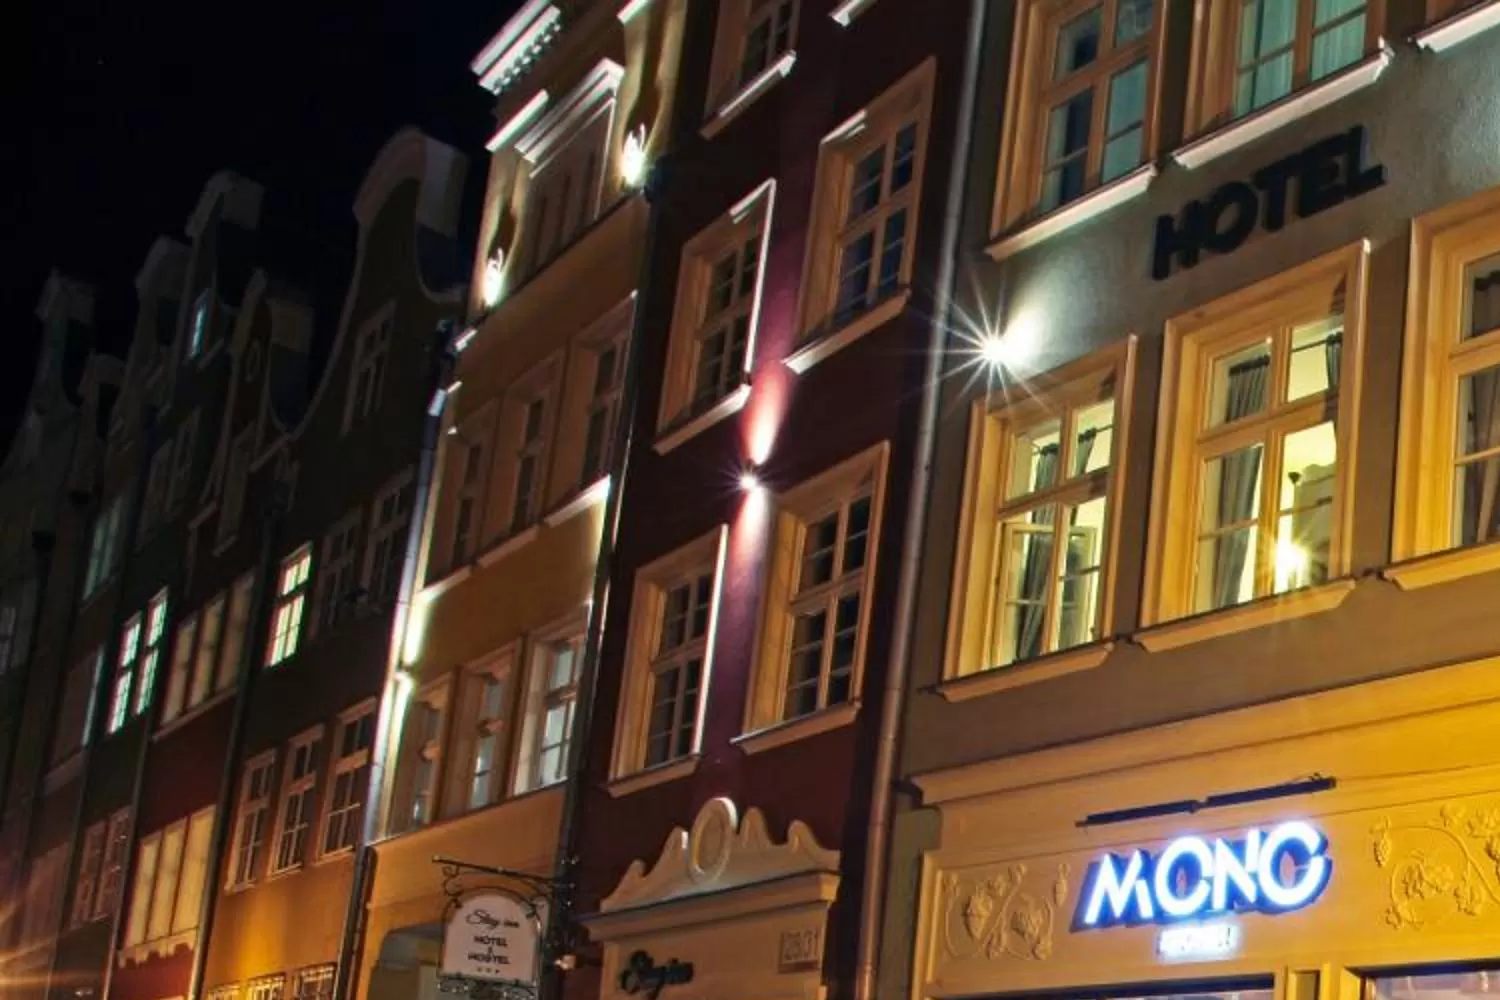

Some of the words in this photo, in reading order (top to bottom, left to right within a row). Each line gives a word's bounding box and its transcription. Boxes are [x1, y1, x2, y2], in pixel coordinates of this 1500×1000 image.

[1151, 123, 1387, 281] HOTEL
[1074, 820, 1332, 932] MONO
[467, 952, 511, 965] HOSTEL
[473, 935, 508, 949] HOTEL
